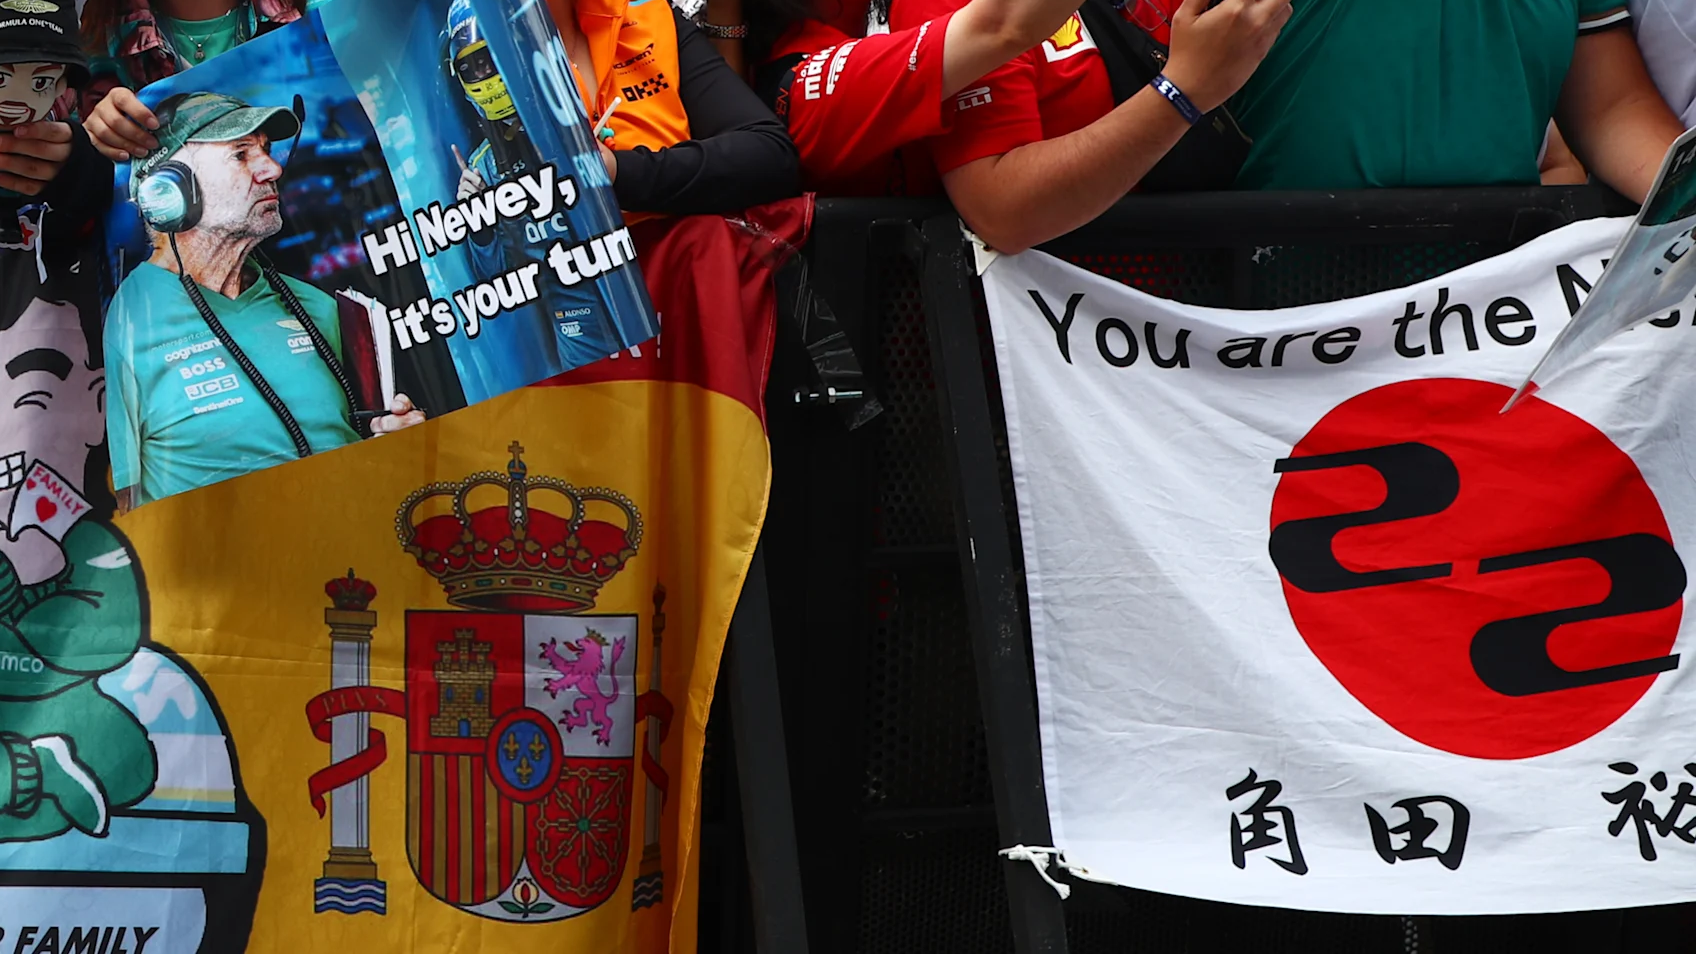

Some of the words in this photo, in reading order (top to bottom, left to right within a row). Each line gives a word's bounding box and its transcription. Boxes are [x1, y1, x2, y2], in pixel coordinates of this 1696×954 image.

[621, 72, 670, 102] OKX
[363, 221, 420, 276] Hi
[414, 165, 577, 255] Newey,
[389, 296, 455, 350] it's
[455, 262, 540, 337] your
[564, 307, 591, 319] ALONSO
[1027, 289, 1193, 369] You
[1215, 325, 1362, 369] are
[1390, 286, 1538, 360] the
[164, 337, 223, 363] cognizant
[179, 357, 227, 380] BOSS
[185, 375, 238, 400] JCB
[193, 396, 244, 415] SentinelOne
[31, 465, 86, 516] FAMILY
[10, 924, 160, 954] FAMILY
